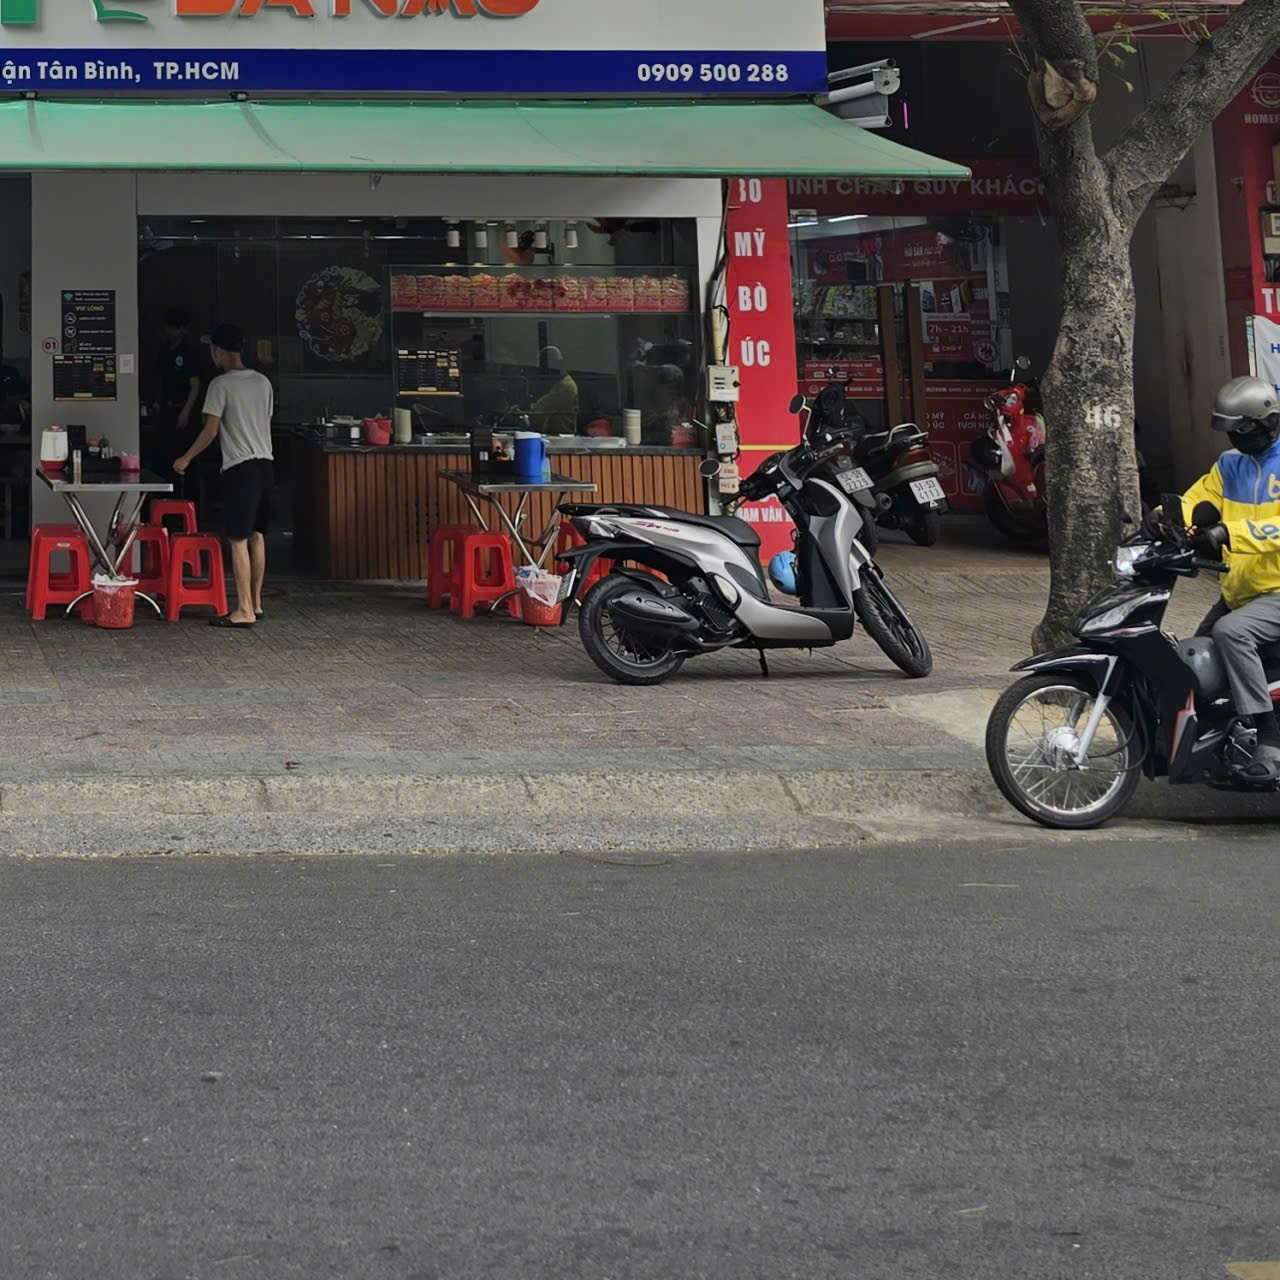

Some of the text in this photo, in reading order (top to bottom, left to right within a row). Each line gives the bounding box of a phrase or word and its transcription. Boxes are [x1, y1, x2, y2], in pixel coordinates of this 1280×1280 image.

[37, 60, 78, 80] Tân
[84, 60, 141, 83] Bình,
[153, 61, 239, 80] TP.HCM
[638, 63, 788, 82] 0909 500 288
[971, 174, 1046, 195] KHÁC
[735, 228, 765, 257] MỸ
[738, 281, 768, 312] BÒ
[929, 324, 942, 334] 7h
[951, 324, 969, 334] 21h
[44, 342, 56, 350] 01
[741, 335, 770, 367] ÚC
[1085, 401, 1122, 429] 46
